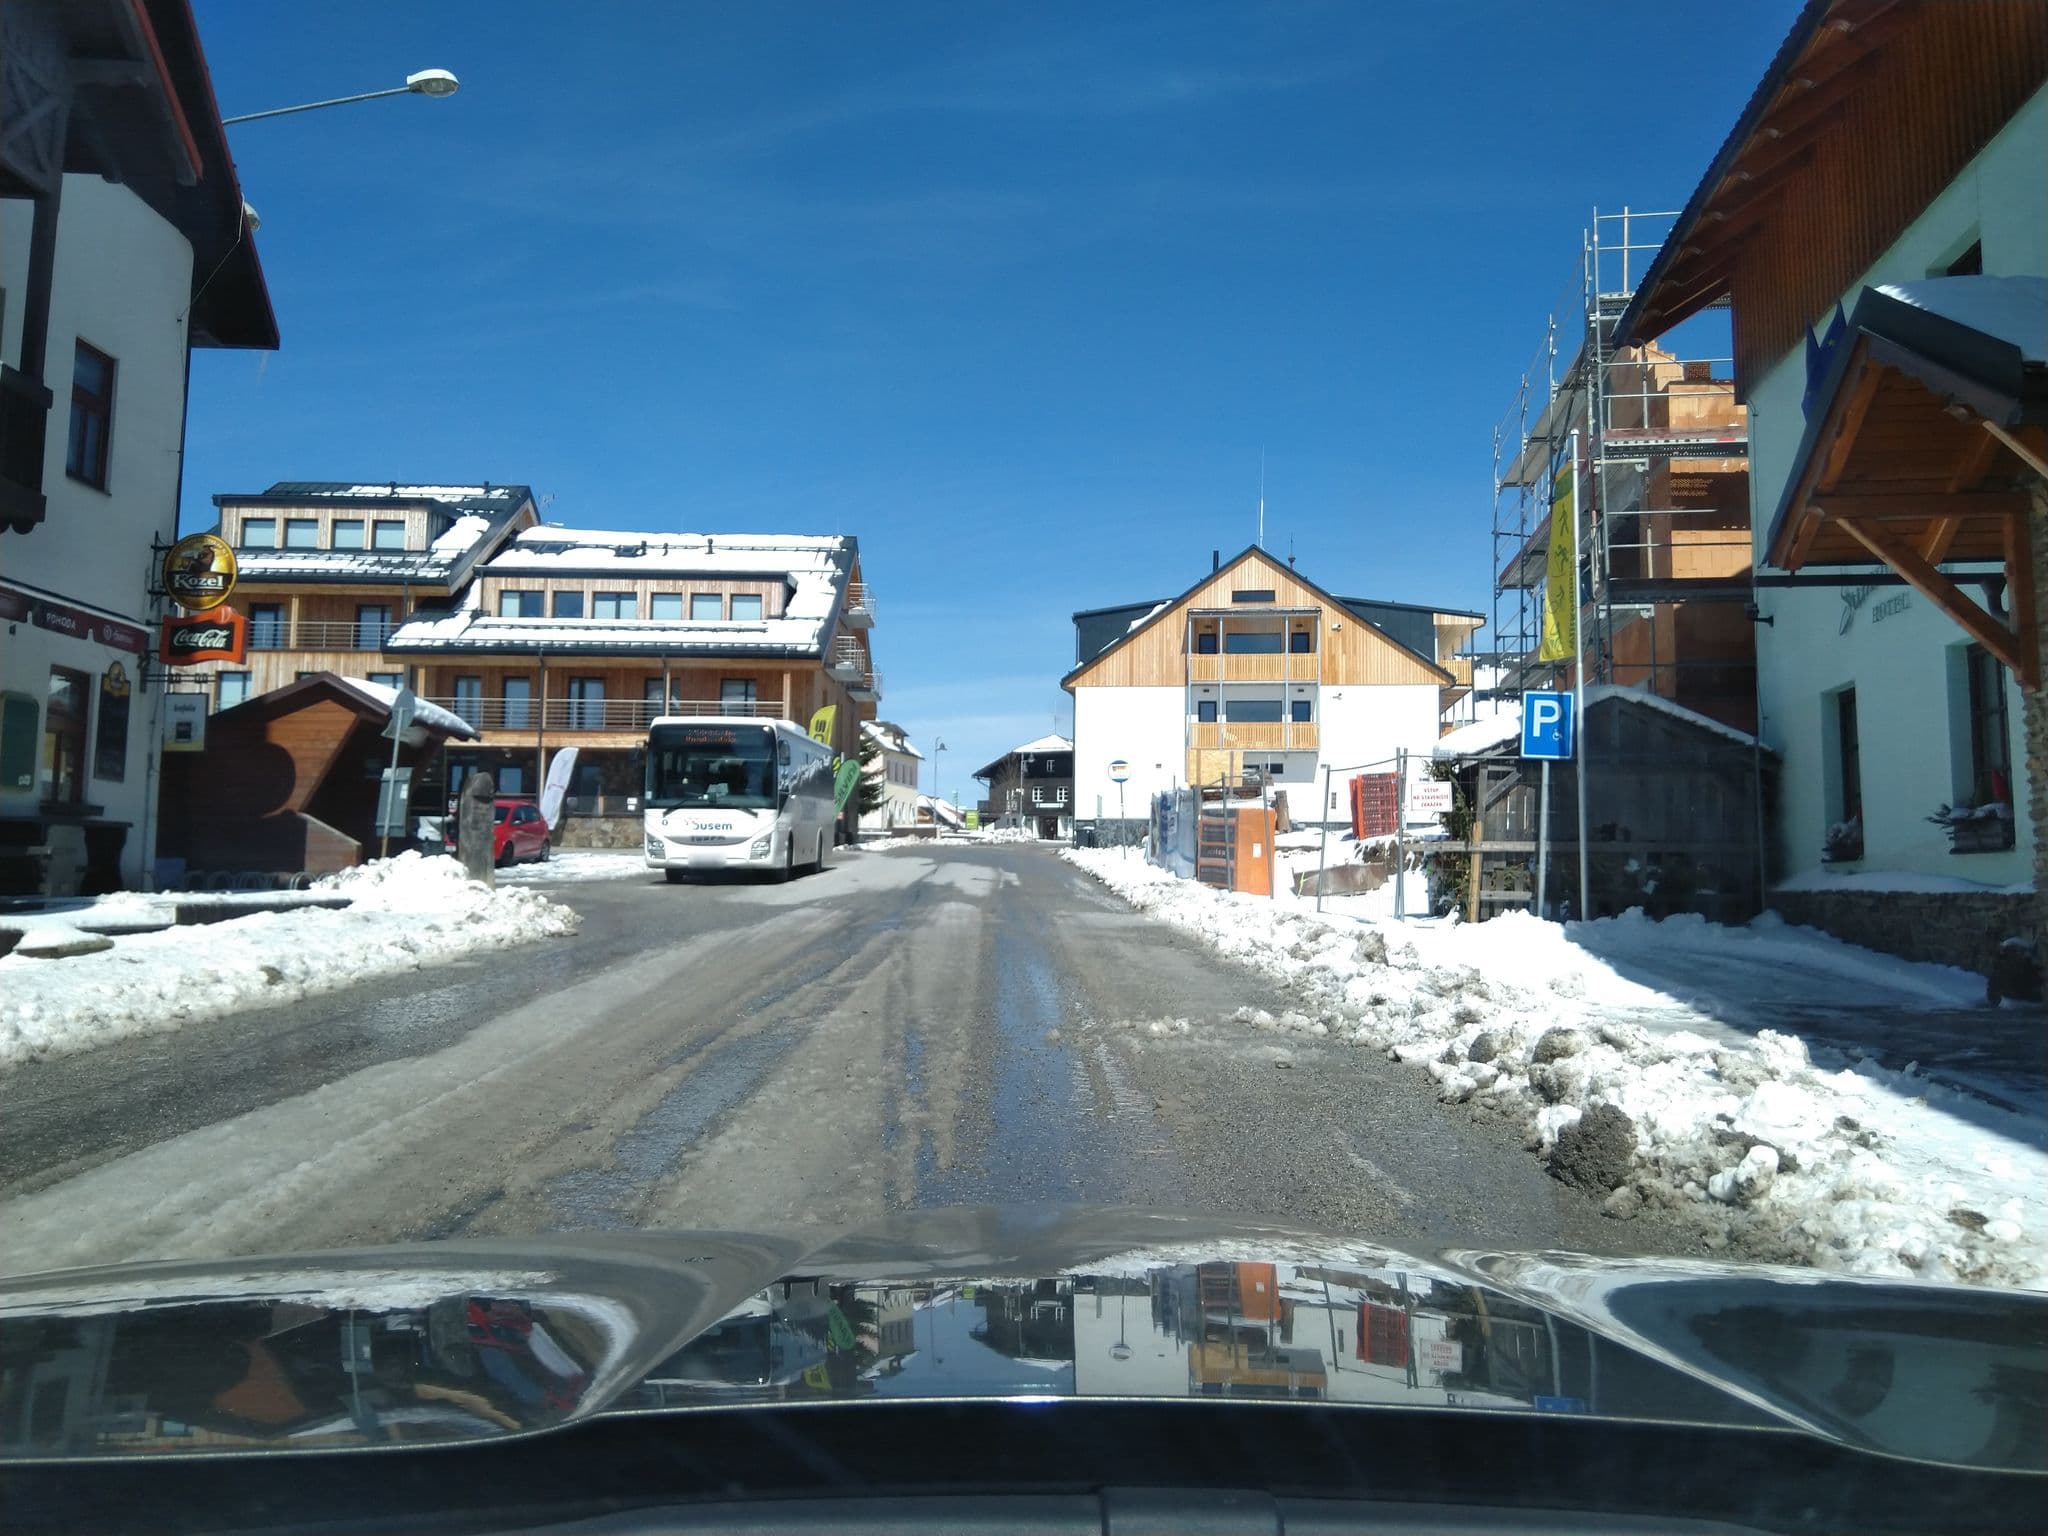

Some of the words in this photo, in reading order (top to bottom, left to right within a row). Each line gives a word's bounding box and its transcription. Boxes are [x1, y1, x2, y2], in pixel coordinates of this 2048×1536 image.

[175, 575, 224, 589] Kozel
[1872, 591, 1913, 623] HOTEL
[46, 612, 77, 630] POHODA
[1533, 699, 1562, 737] P
